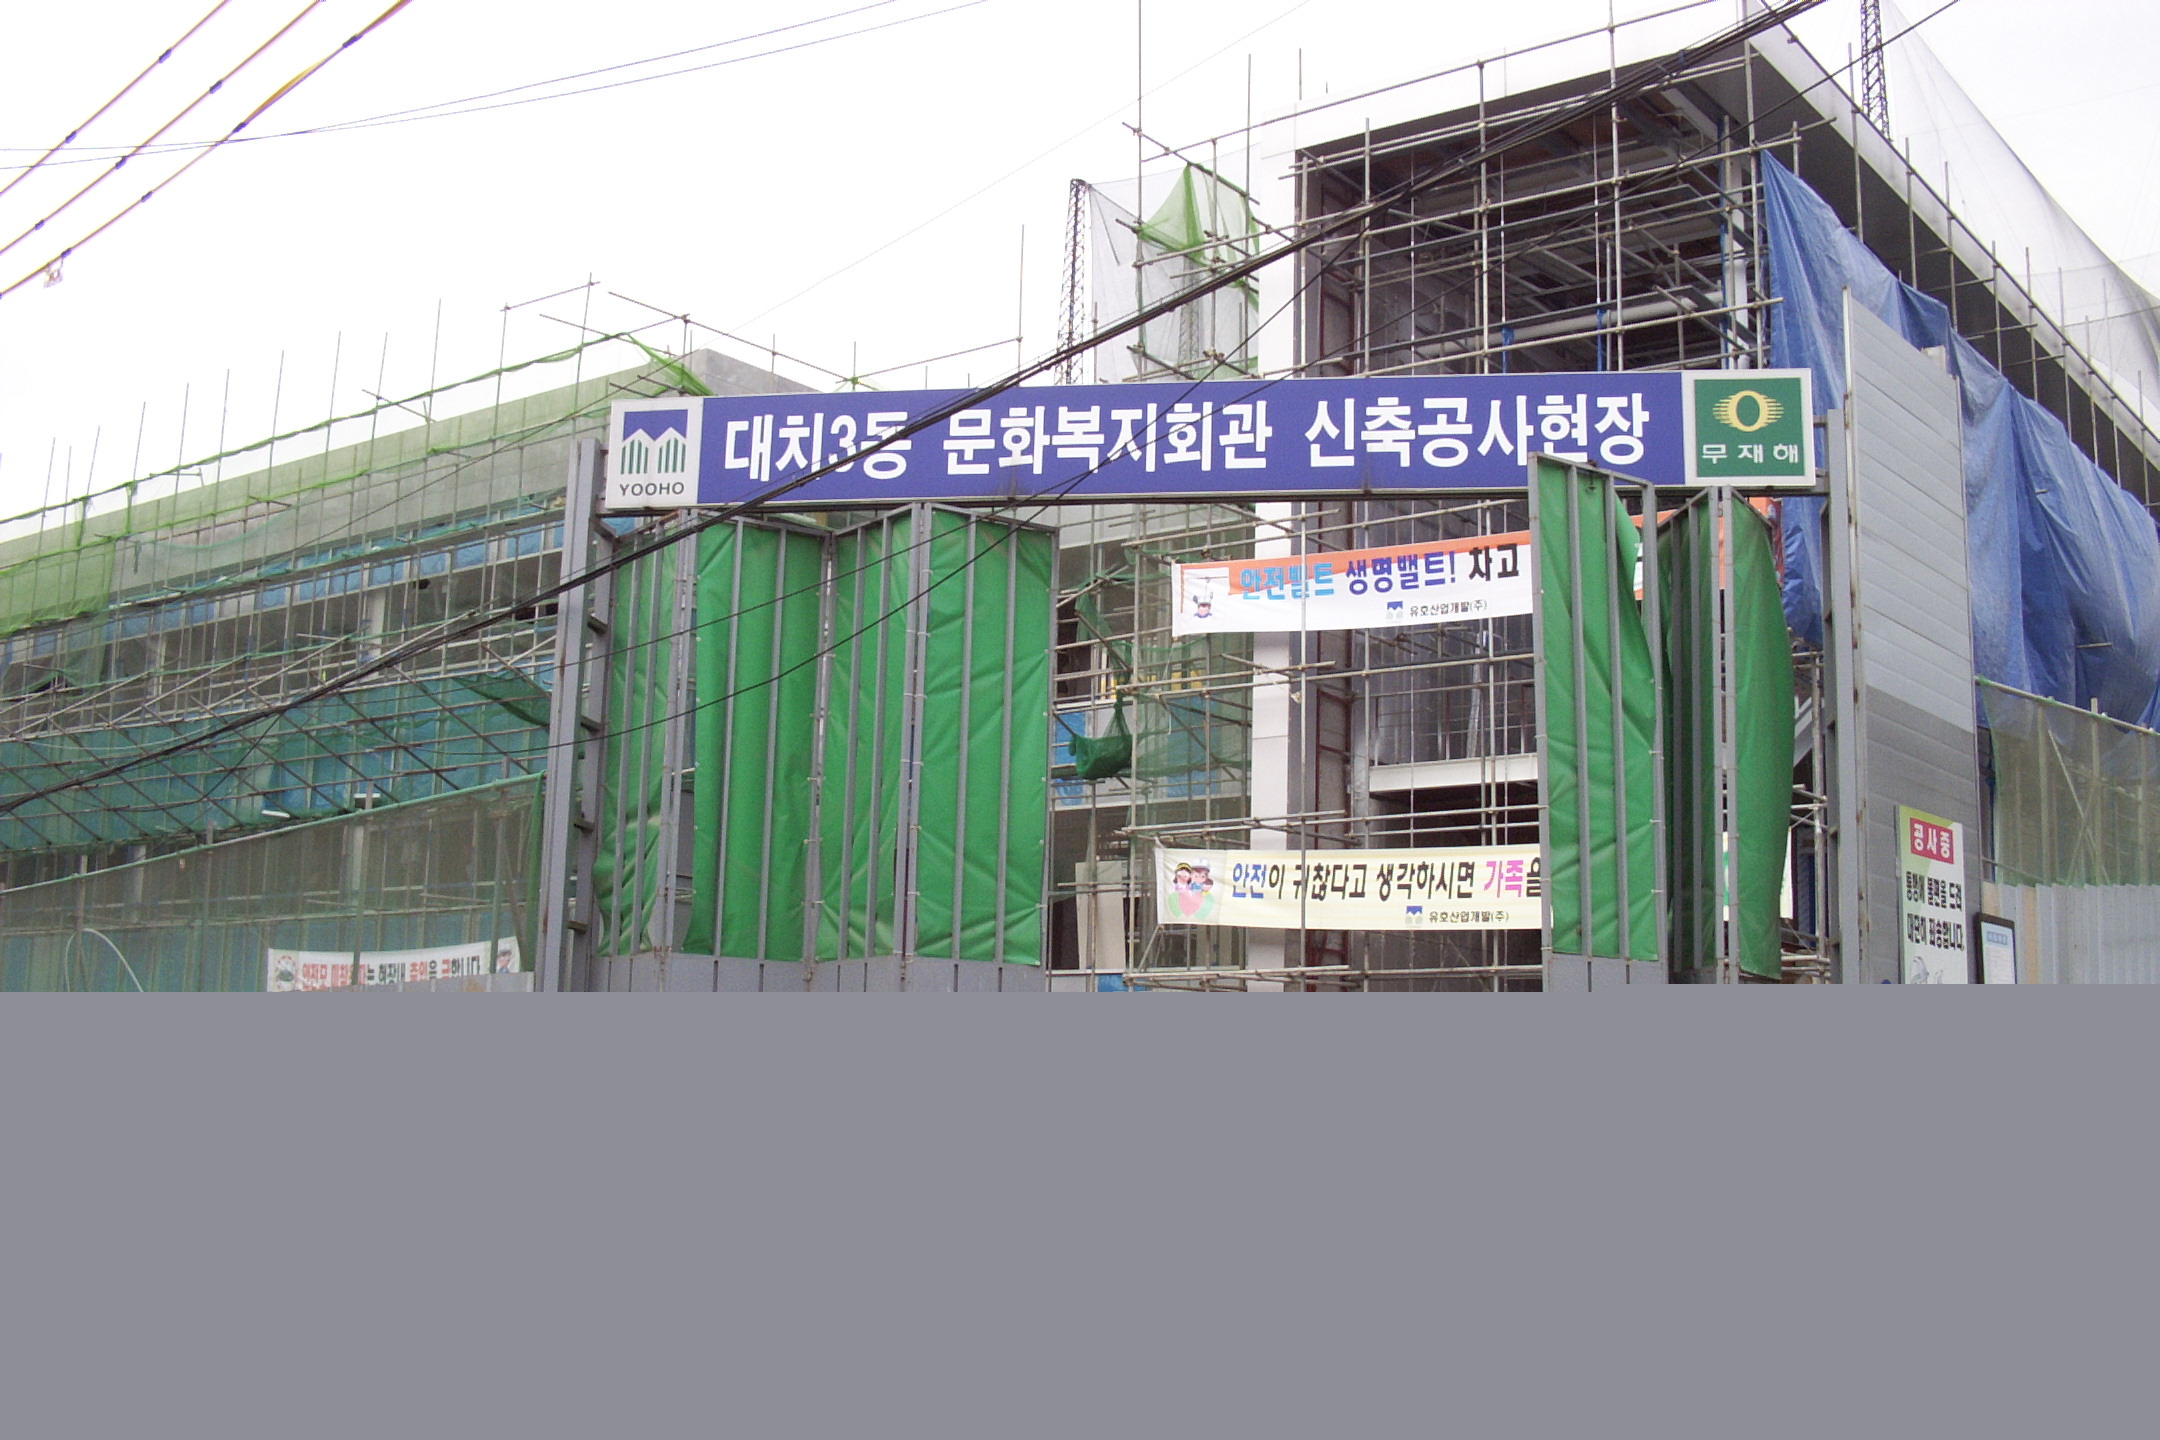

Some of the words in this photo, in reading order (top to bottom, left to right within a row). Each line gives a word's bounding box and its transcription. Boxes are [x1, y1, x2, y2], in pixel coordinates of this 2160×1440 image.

[725, 411, 912, 482] 대치3동
[943, 400, 1273, 475] 문화복지회관
[1305, 392, 1650, 469] 신축공사현장
[620, 481, 685, 497] YOOHO
[1345, 550, 1457, 596] 생명밸트!
[1469, 543, 1520, 582] 차고
[1913, 822, 1951, 859] 공사중
[1232, 862, 1286, 900] 안전이
[1293, 861, 1368, 902] 귀찮다고
[1376, 860, 1476, 902] 생각하시면
[1484, 856, 1542, 899] 가족을
